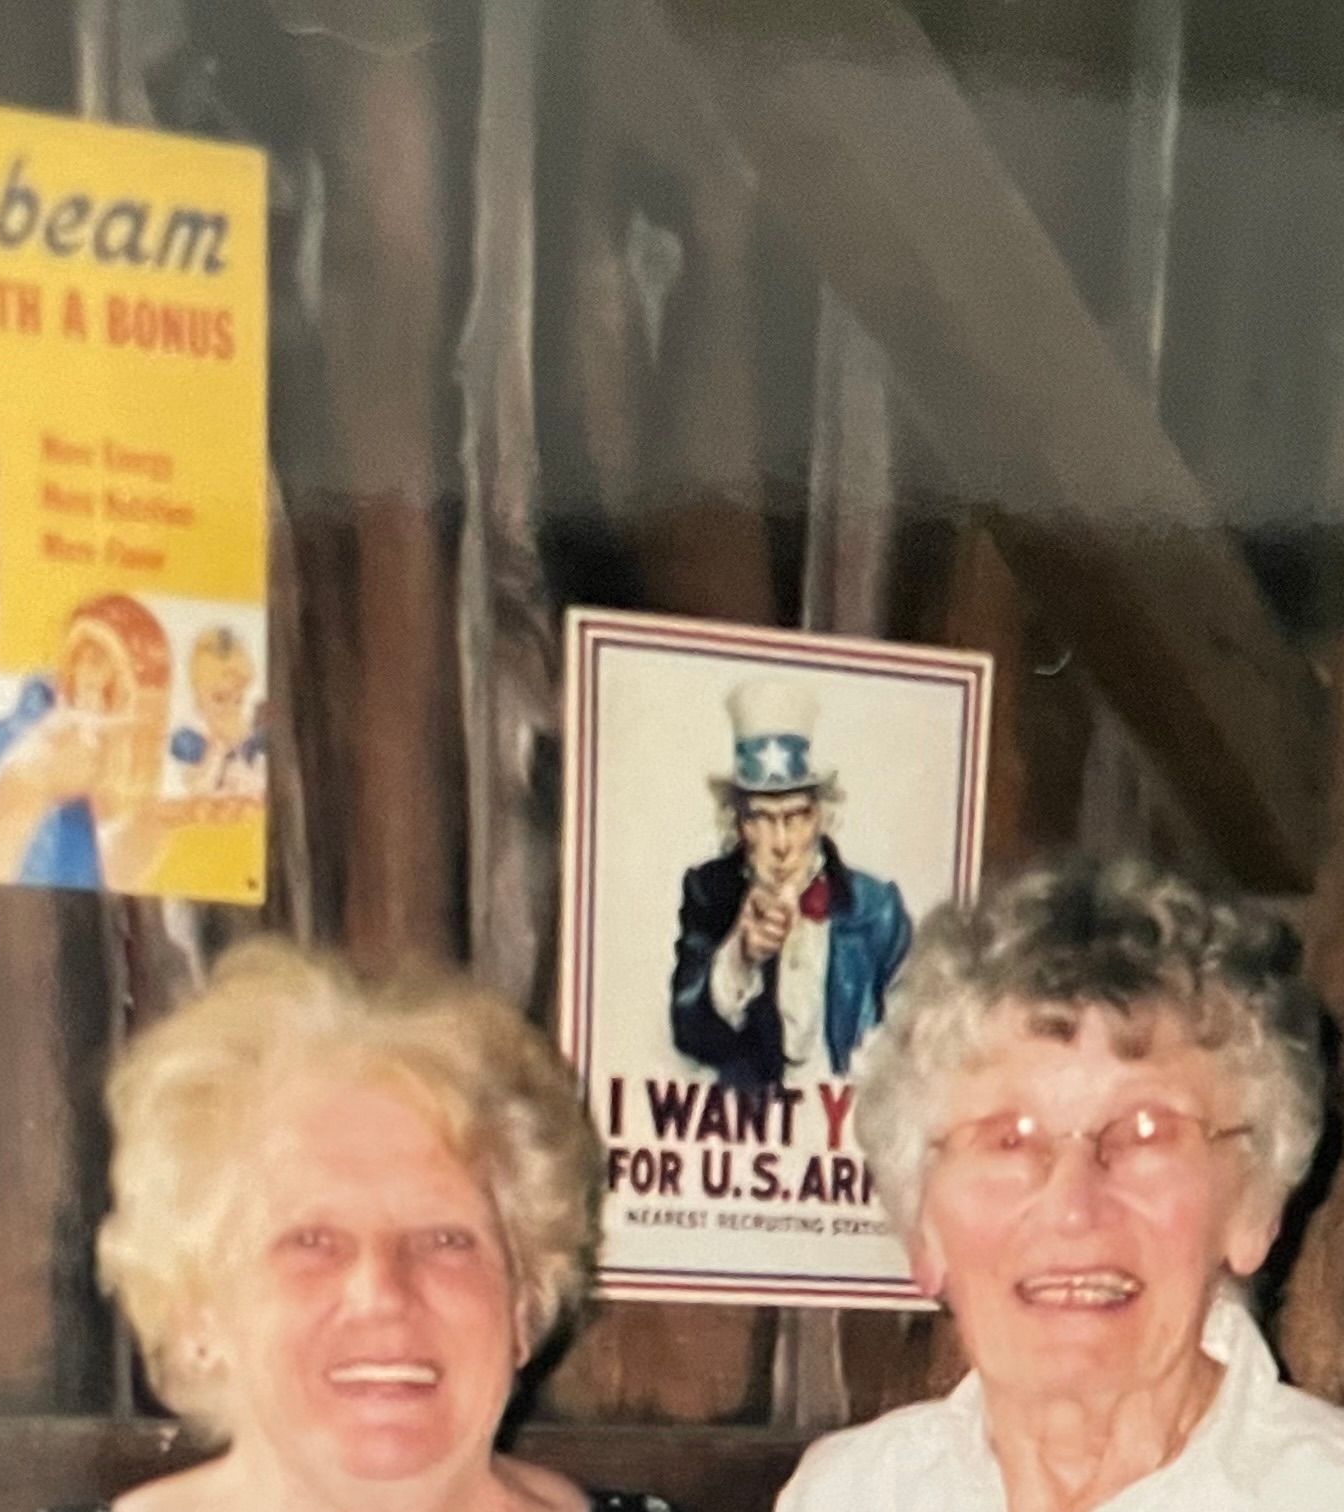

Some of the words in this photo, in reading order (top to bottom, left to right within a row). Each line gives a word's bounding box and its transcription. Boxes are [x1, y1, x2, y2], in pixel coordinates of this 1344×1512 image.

[62, 289, 86, 342] A
[106, 295, 236, 361] BONUS
[609, 1077, 622, 1138] I
[645, 1078, 804, 1146] WANT
[608, 1148, 682, 1196] FOR
[624, 1208, 708, 1230] NEAREST
[718, 1214, 825, 1235] RECRUITING
